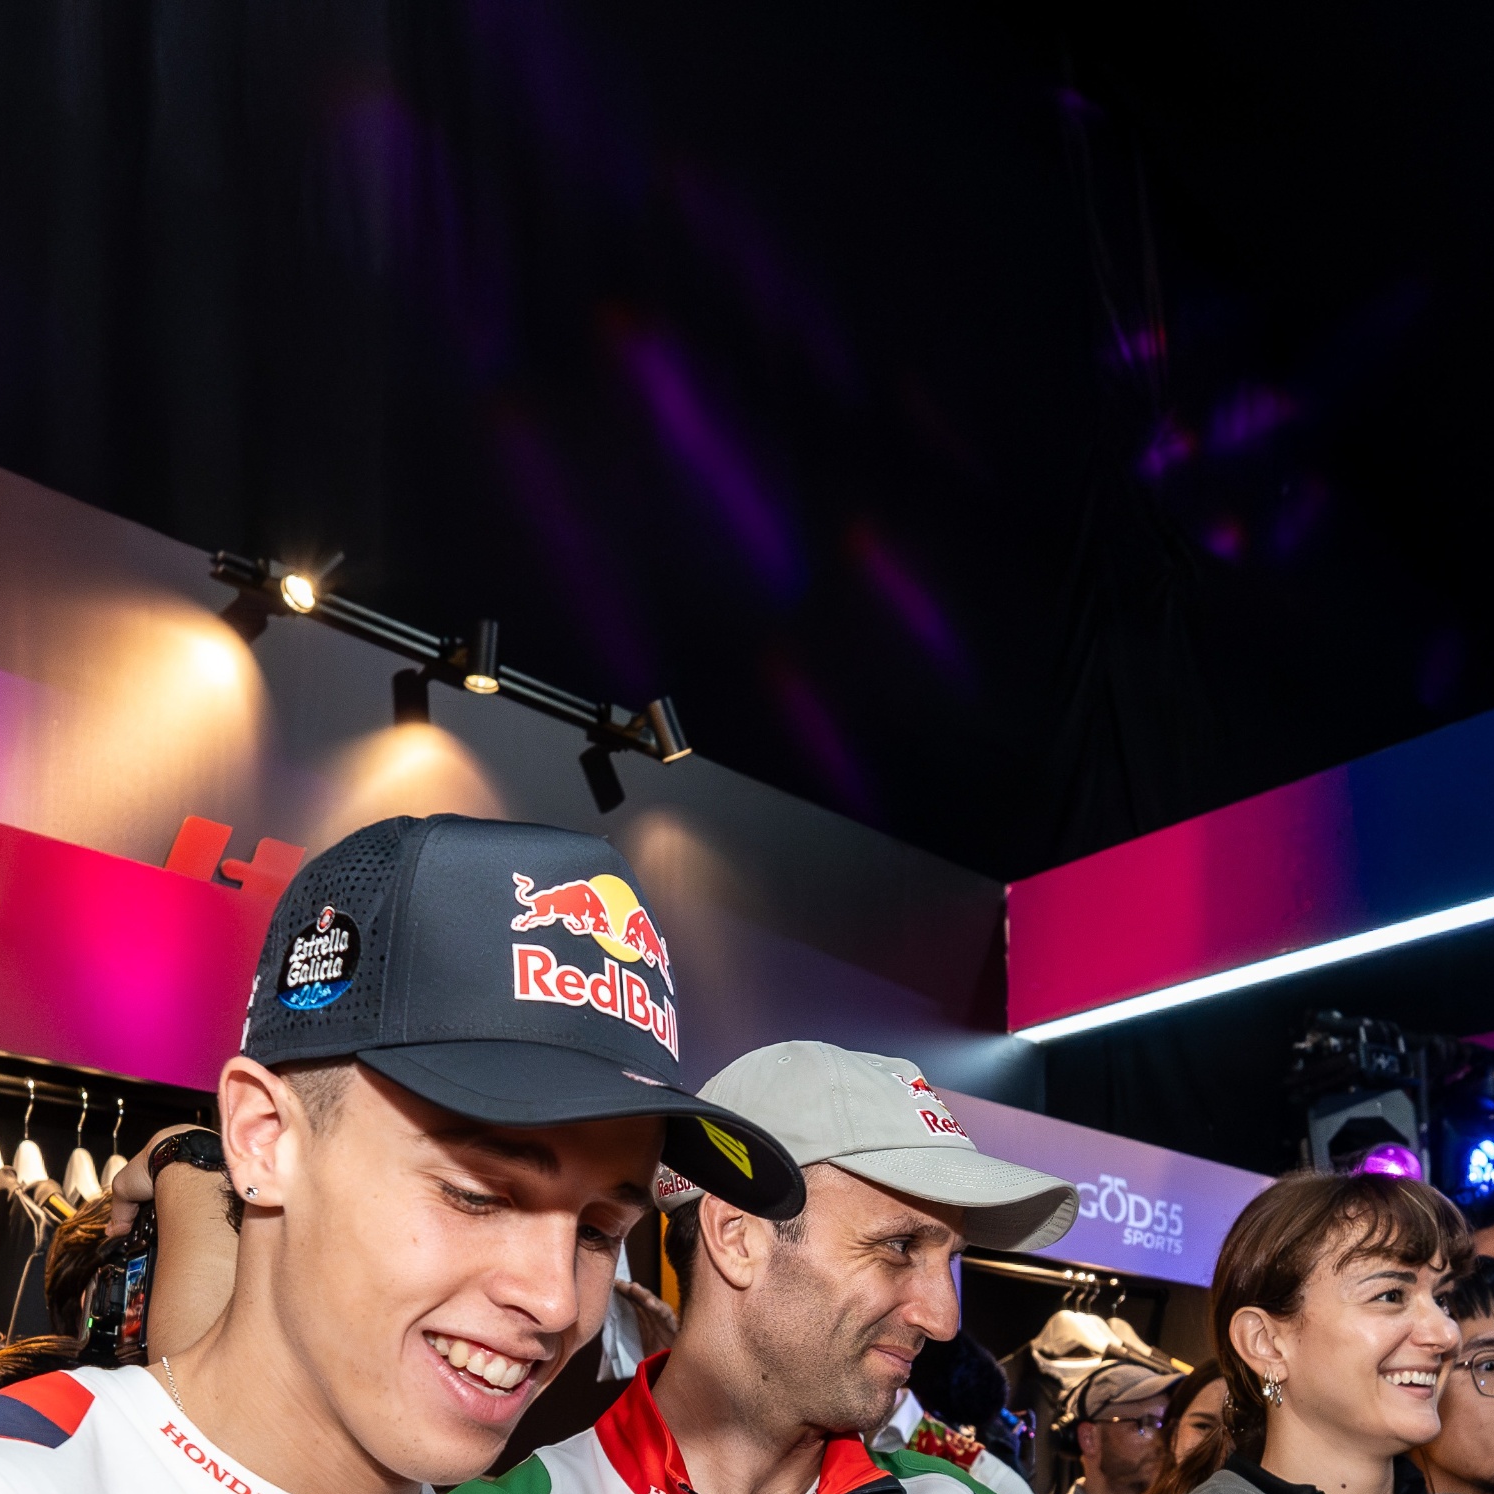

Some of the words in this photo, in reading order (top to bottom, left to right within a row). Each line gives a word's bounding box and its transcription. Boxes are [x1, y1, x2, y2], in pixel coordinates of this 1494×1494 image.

[289, 927, 350, 963] Estrella
[286, 953, 344, 988] Galicia
[1122, 1227, 1184, 1255] SPORTS
